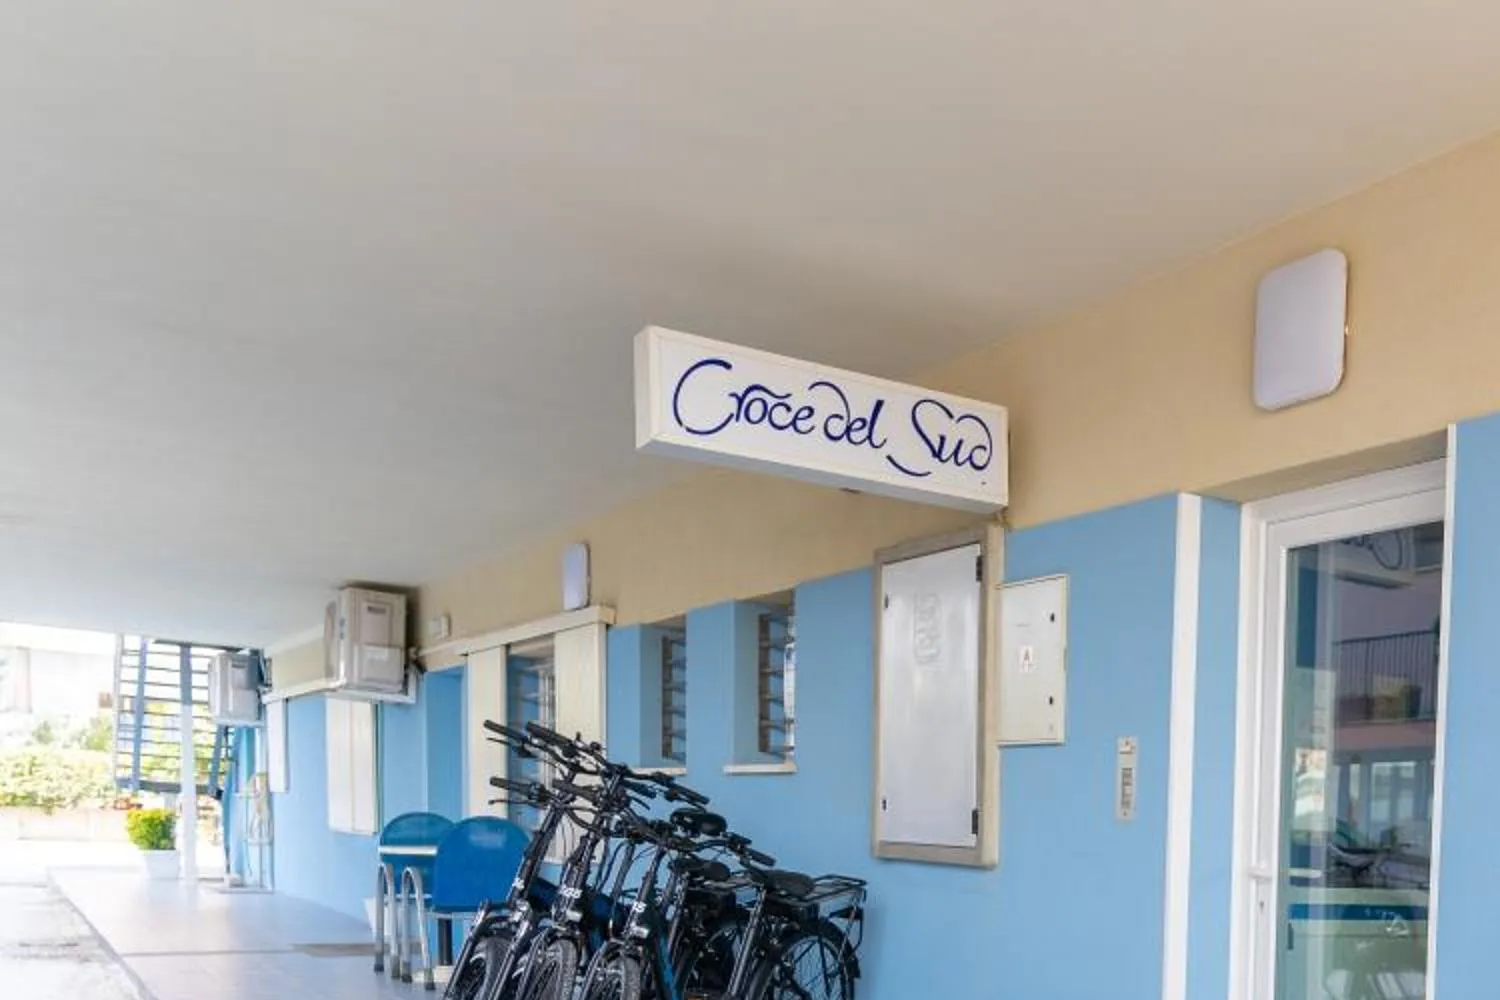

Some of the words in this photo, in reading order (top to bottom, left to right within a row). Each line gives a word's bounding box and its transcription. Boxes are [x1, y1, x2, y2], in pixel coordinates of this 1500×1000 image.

[673, 358, 815, 435] Croce
[808, 381, 887, 449] del
[886, 398, 993, 477] Sud
